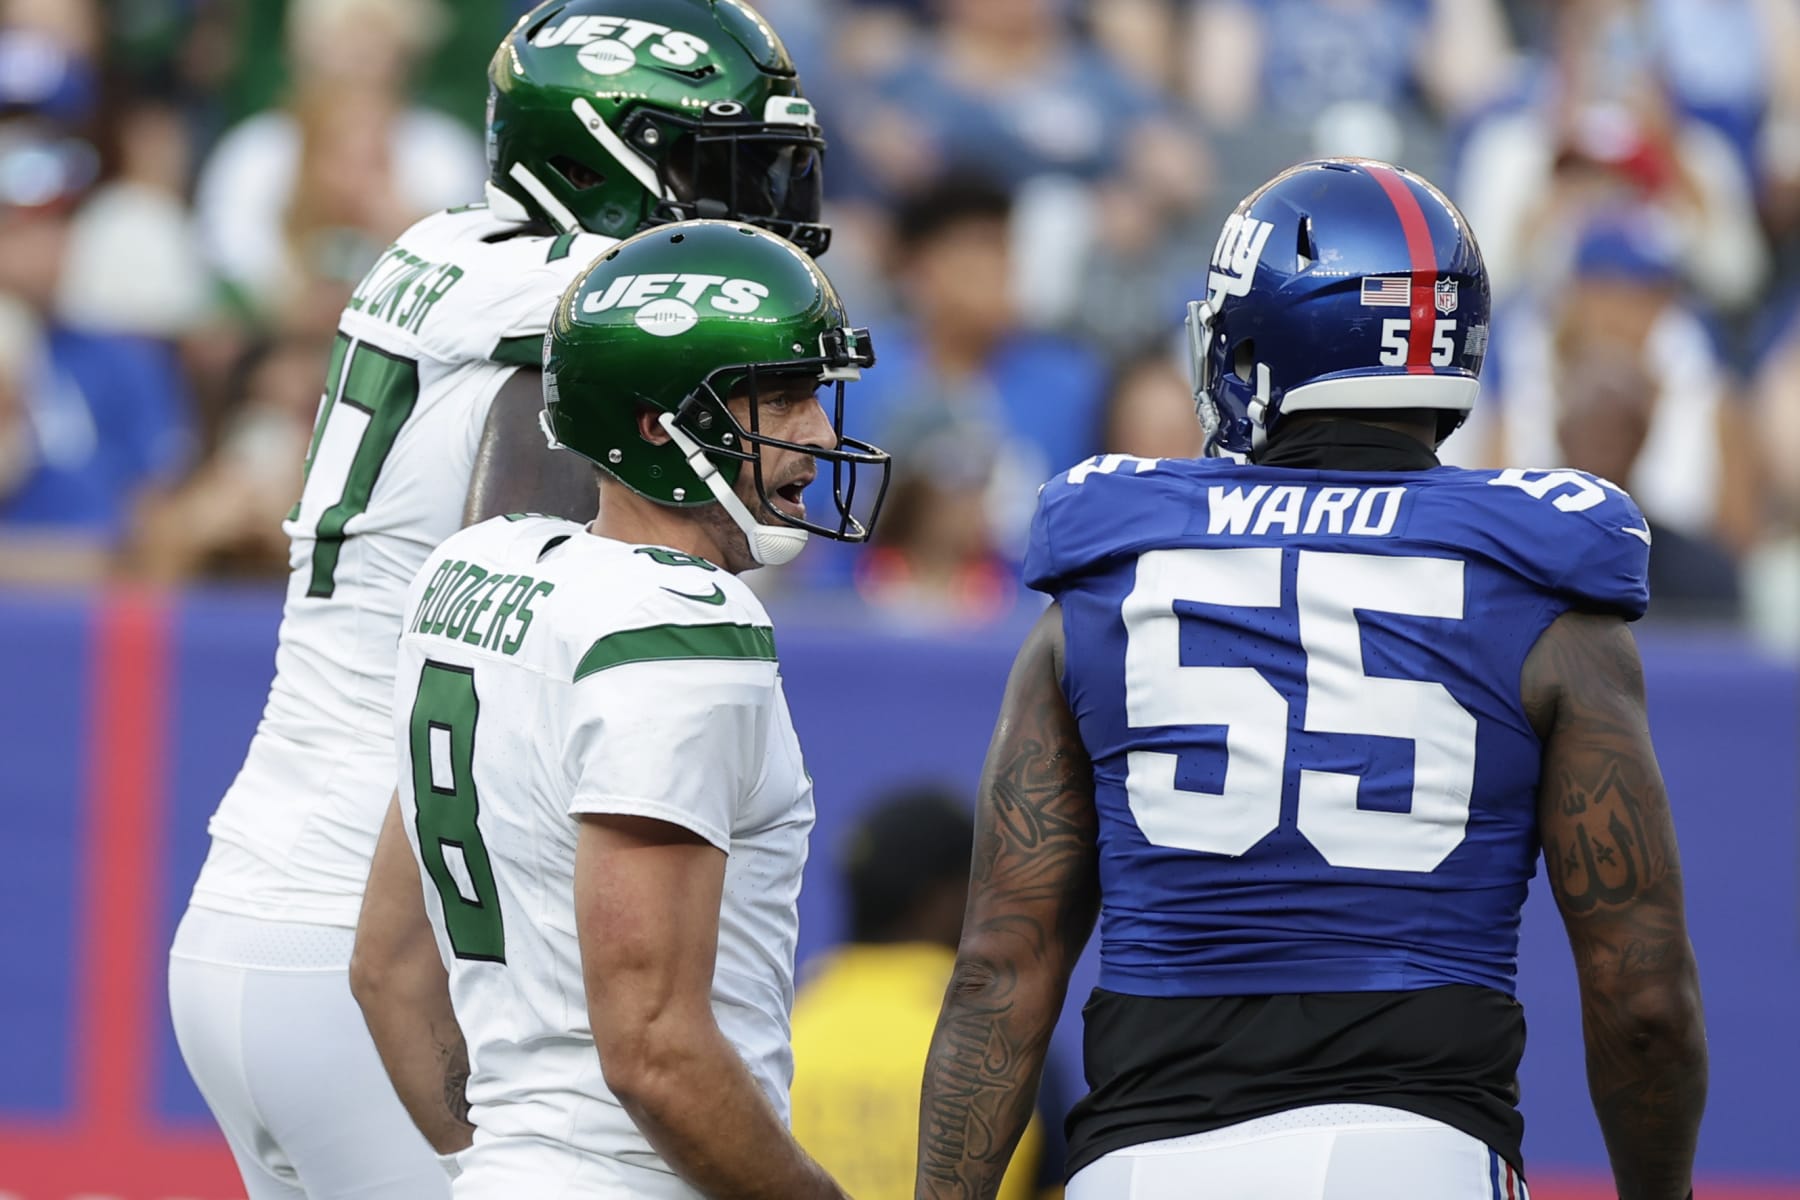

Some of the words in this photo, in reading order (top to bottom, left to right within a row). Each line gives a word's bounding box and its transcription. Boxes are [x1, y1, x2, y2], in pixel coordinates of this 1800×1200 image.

[534, 15, 709, 66] JETS
[583, 274, 769, 314] JETS
[1207, 486, 1406, 535] WARD
[409, 559, 555, 656] RODGERS
[1122, 547, 1477, 873] 55
[410, 658, 507, 966] 8
